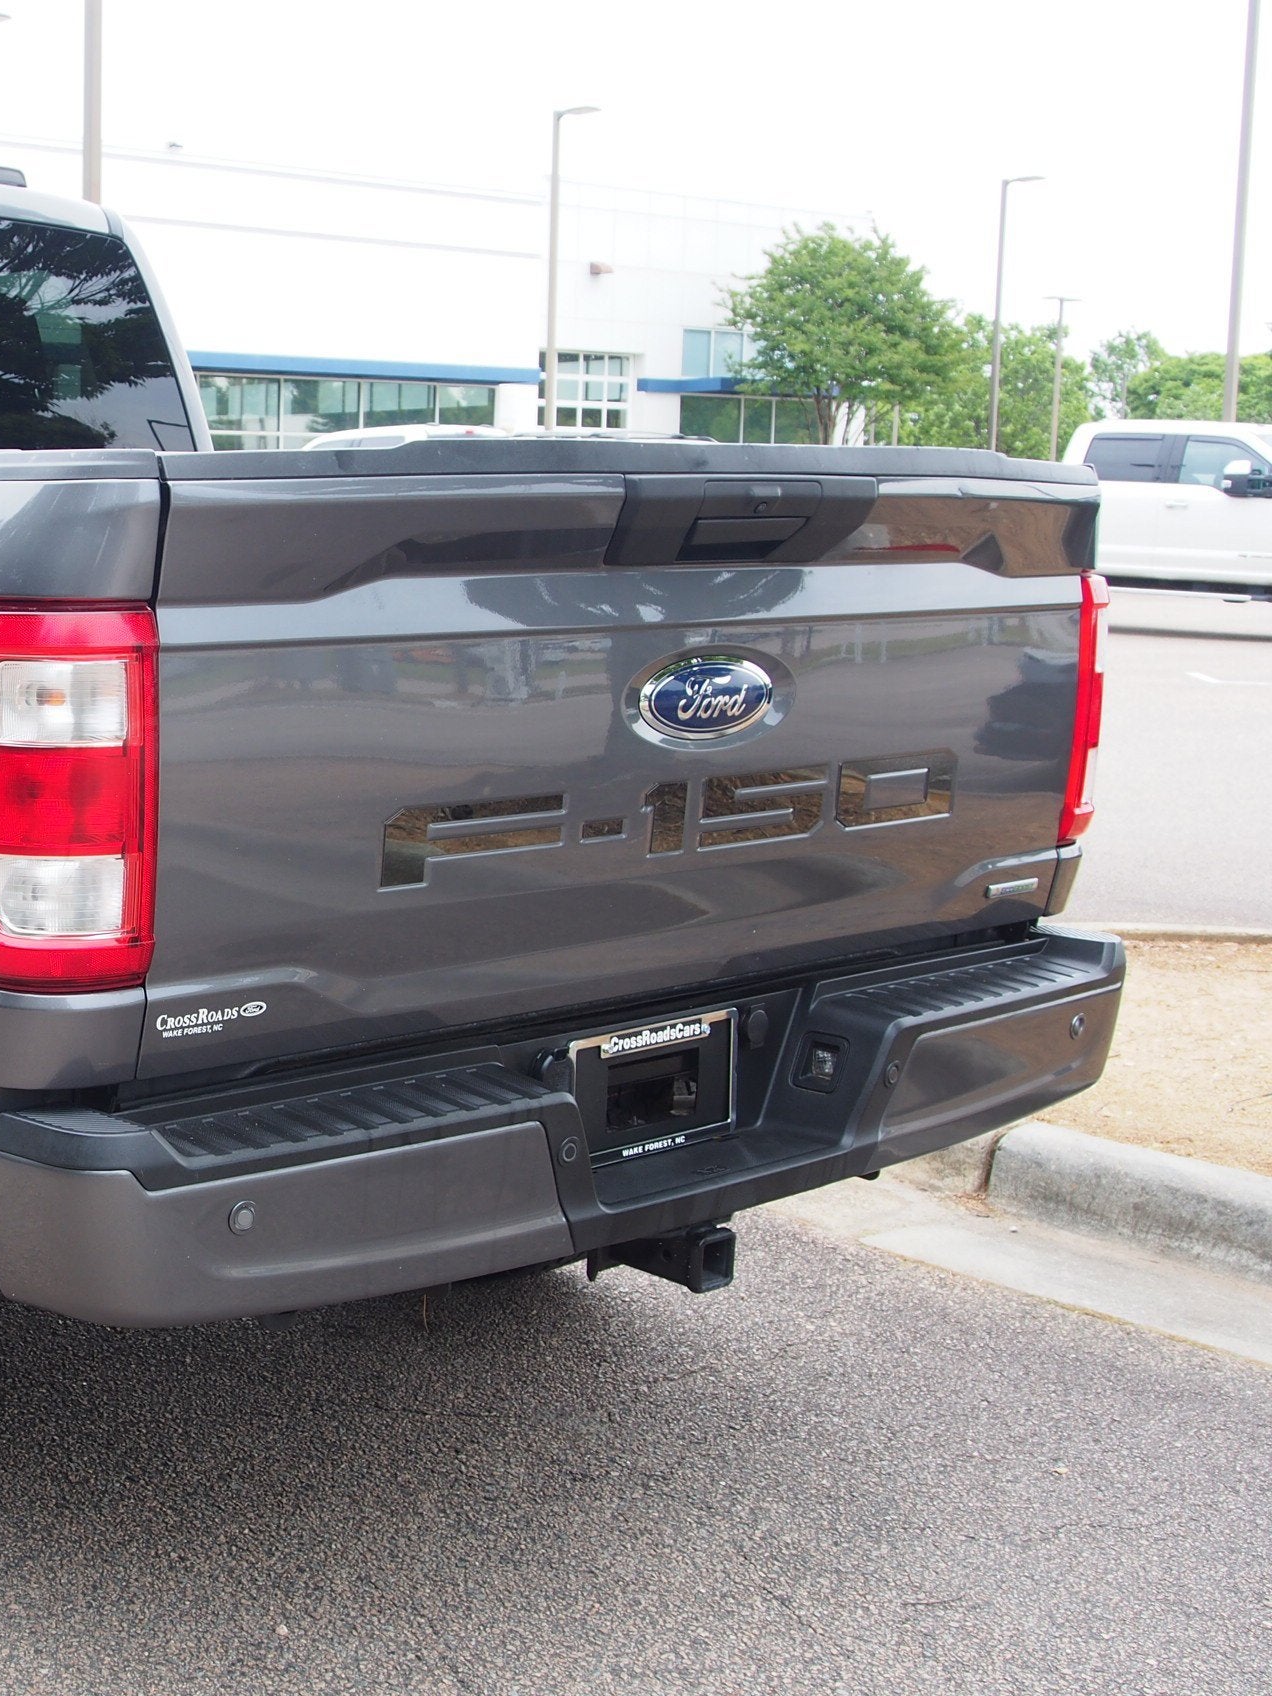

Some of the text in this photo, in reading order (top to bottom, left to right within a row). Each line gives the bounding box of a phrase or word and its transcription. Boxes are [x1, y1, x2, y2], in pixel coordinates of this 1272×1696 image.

[678, 675, 748, 721] Ford
[377, 748, 958, 892] F-150
[162, 1024, 224, 1038] WAKE FOREST, NC
[609, 1023, 702, 1053] CrossRoadsCars
[622, 1135, 686, 1157] WAKE FOREST, NC
